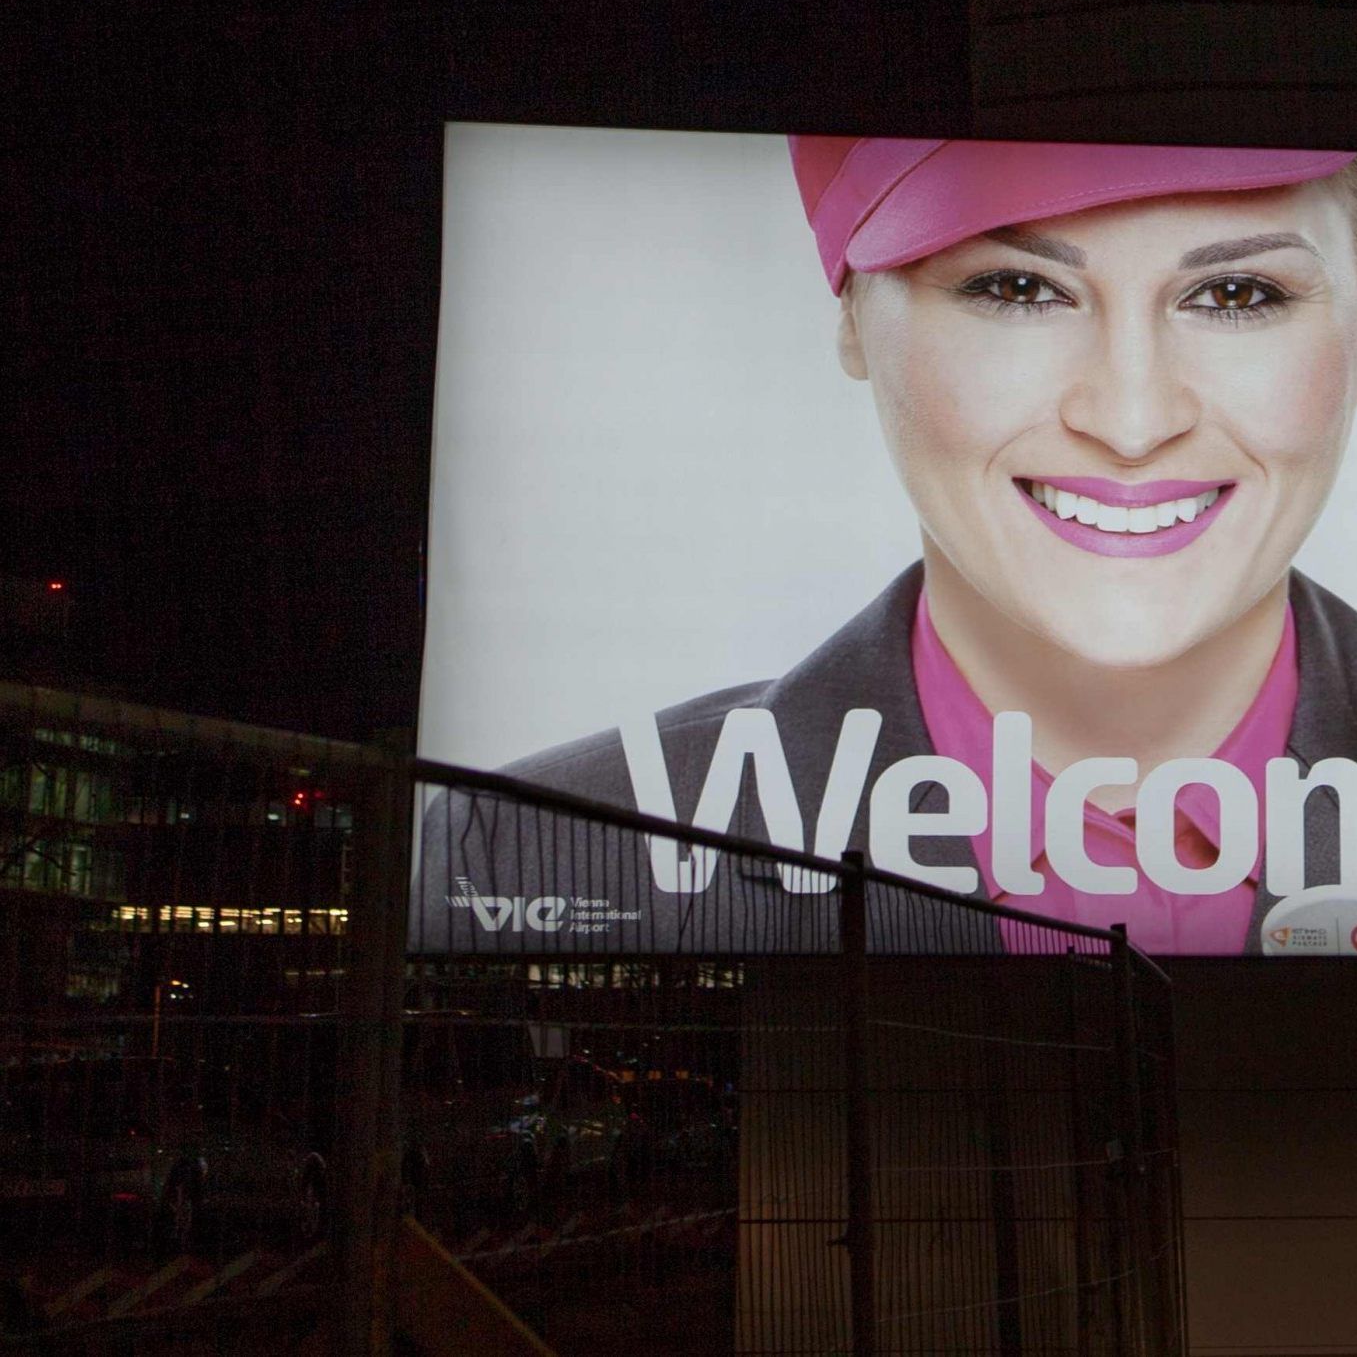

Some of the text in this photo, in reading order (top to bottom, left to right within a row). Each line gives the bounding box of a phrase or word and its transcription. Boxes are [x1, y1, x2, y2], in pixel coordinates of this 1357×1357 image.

[569, 897, 610, 908] Vienna
[570, 909, 642, 920] International
[569, 922, 610, 934] Airport
